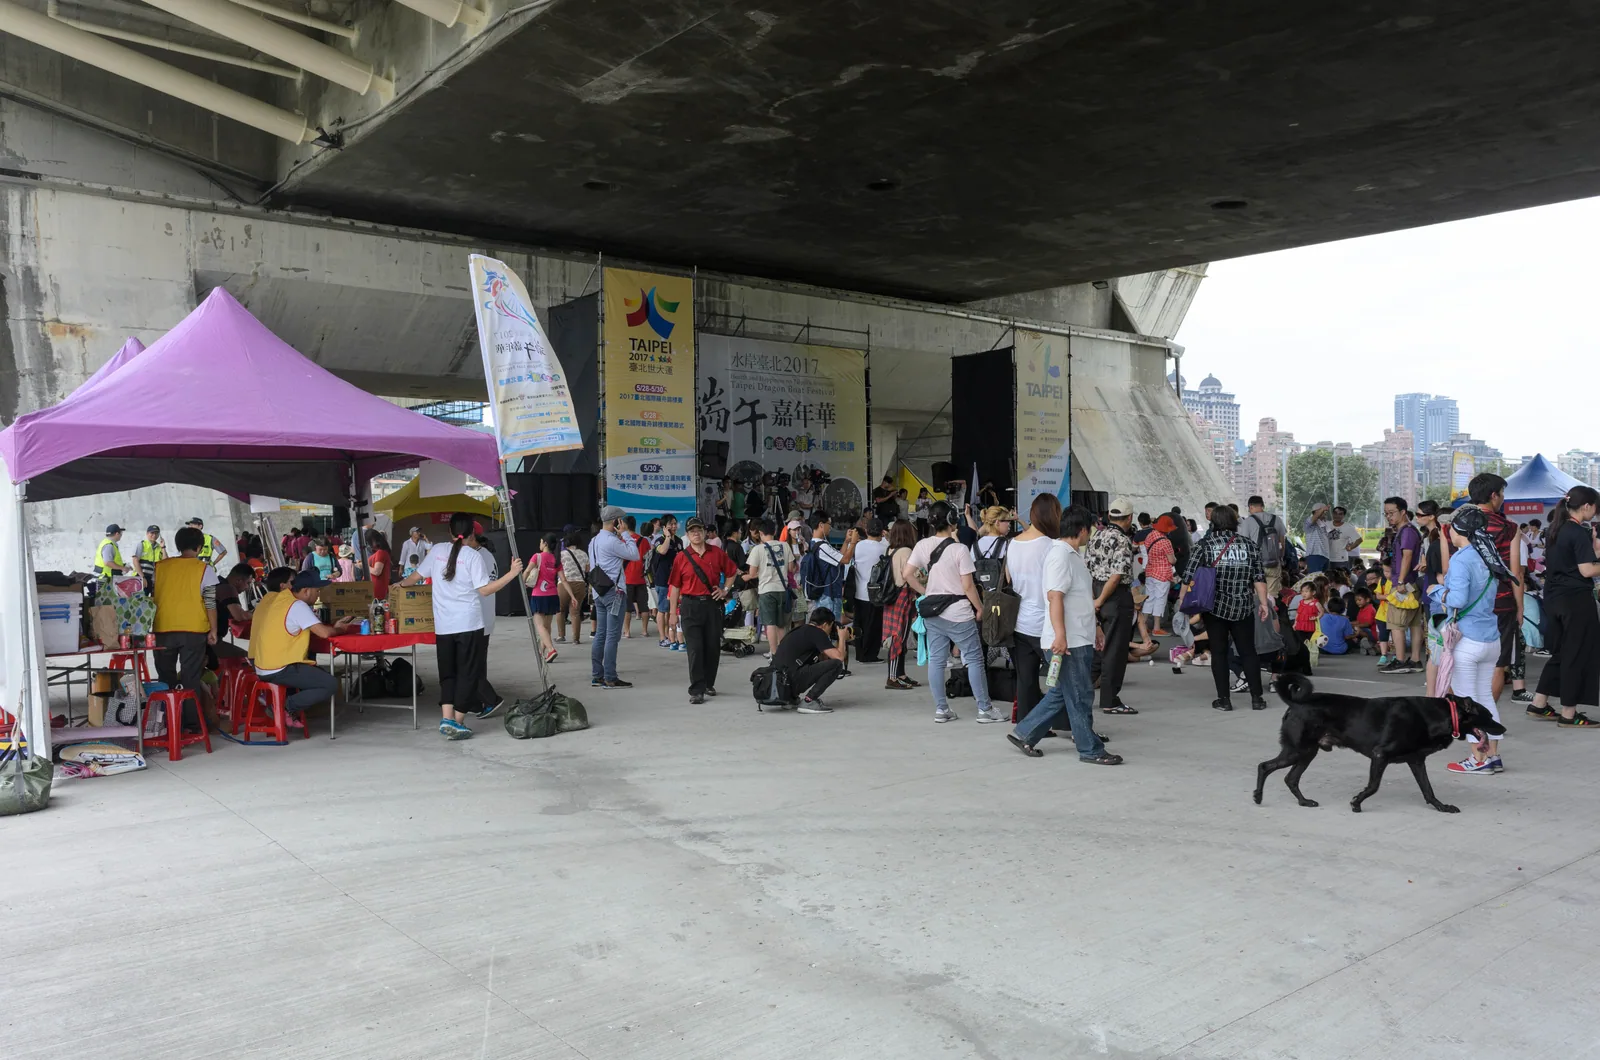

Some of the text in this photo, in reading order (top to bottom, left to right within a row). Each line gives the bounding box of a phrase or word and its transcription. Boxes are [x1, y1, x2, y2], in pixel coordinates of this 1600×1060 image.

[628, 337, 672, 354] TAIPEI
[628, 352, 649, 362] 2017
[628, 362, 673, 375] 臺北世大運
[636, 384, 664, 394] 5/28-5/30
[730, 380, 836, 397] Taipei Dragon Boat Festival
[1025, 382, 1063, 400] TAIPEI
[643, 411, 657, 419] 5/28
[643, 438, 657, 446] 5/29
[1213, 549, 1248, 561] PLAID
